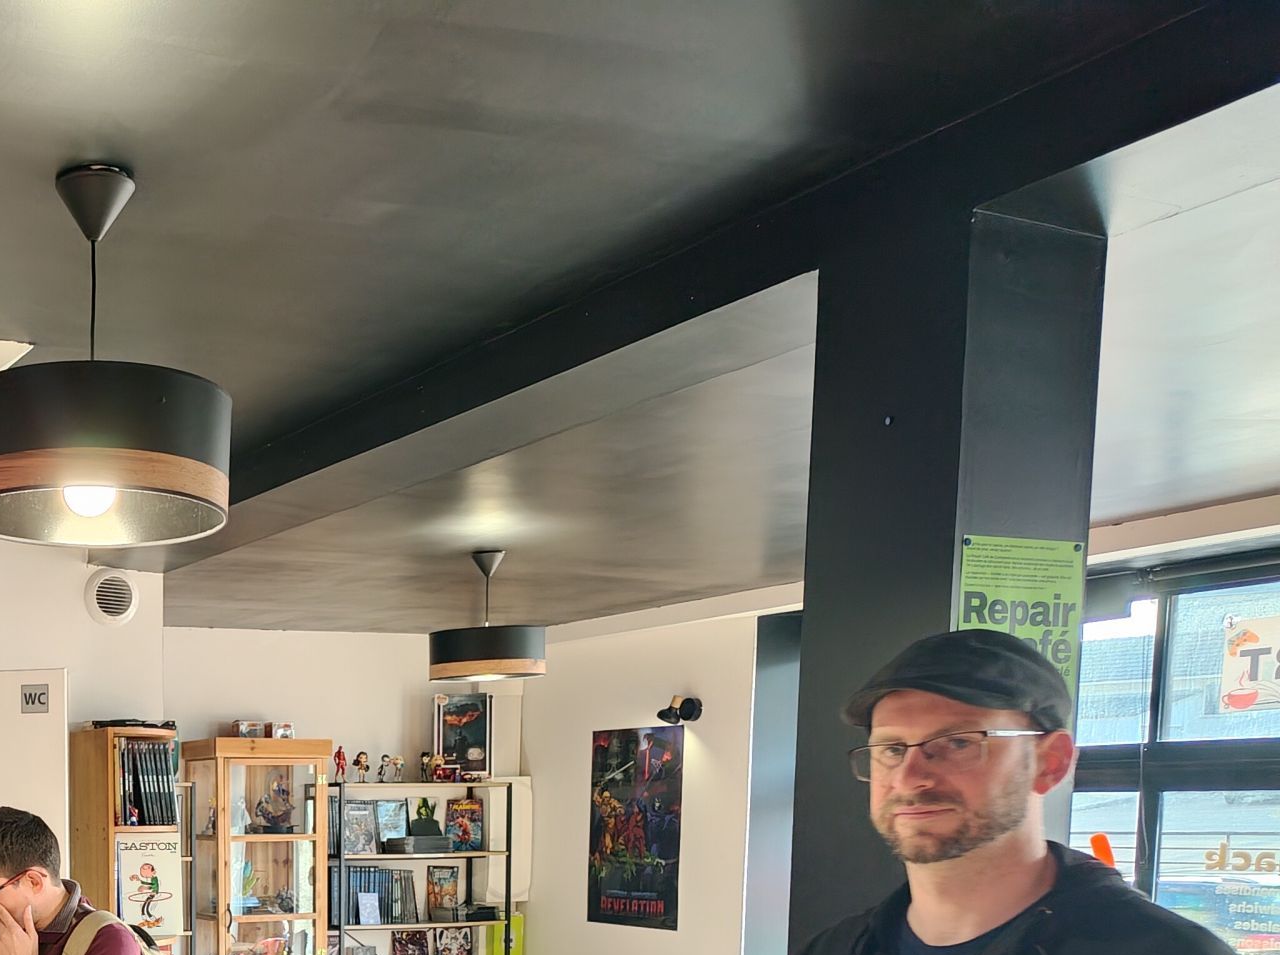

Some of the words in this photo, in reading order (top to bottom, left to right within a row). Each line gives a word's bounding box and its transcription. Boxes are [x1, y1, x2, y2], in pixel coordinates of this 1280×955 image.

[962, 590, 1077, 635] Repair
[23, 691, 47, 706] WC
[119, 842, 178, 851] GASTON
[600, 895, 665, 913] REVELATION
